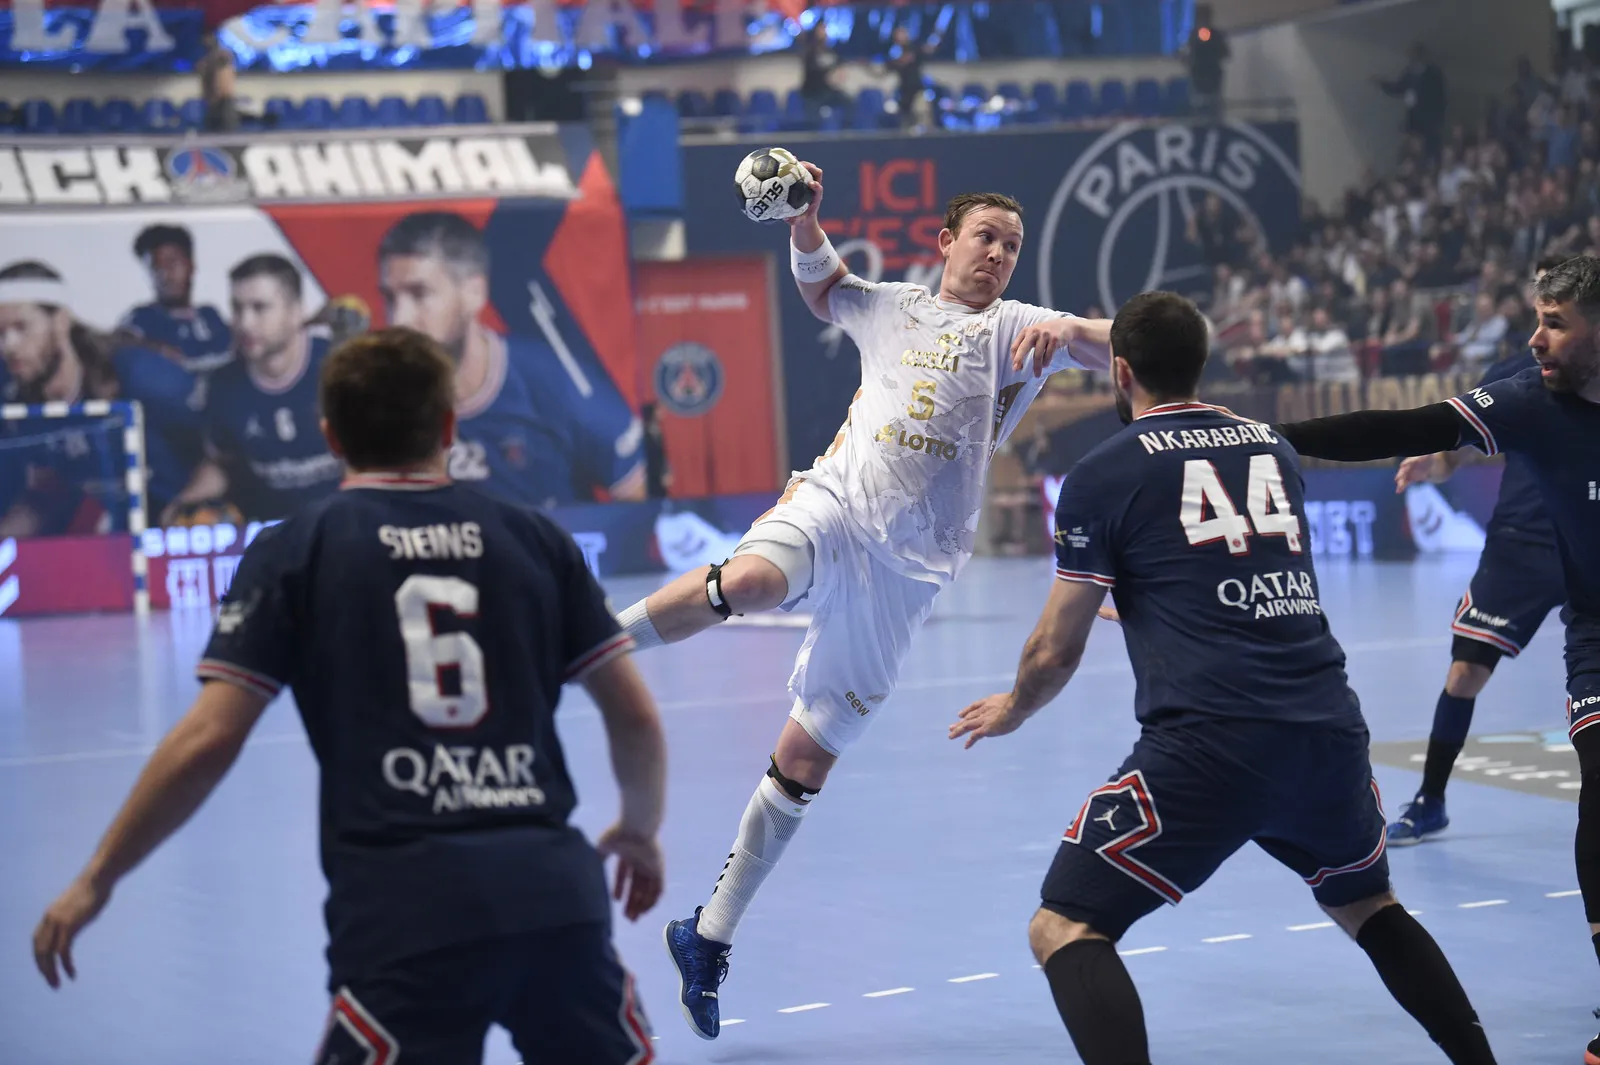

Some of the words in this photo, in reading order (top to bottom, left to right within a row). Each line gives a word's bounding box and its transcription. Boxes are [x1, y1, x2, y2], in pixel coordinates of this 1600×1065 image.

[244, 137, 580, 197] ANIMAL
[859, 159, 937, 212] ICI
[1075, 124, 1261, 218] PARIS
[906, 380, 937, 421] 5
[898, 429, 957, 461] LOTTO
[1178, 453, 1302, 557] 44
[377, 521, 483, 561] STEINS
[1217, 571, 1315, 612] QATAR
[1254, 598, 1321, 620] AIRWAYS
[394, 574, 491, 729] 6
[845, 690, 870, 717] eew
[382, 743, 537, 797] QATAR
